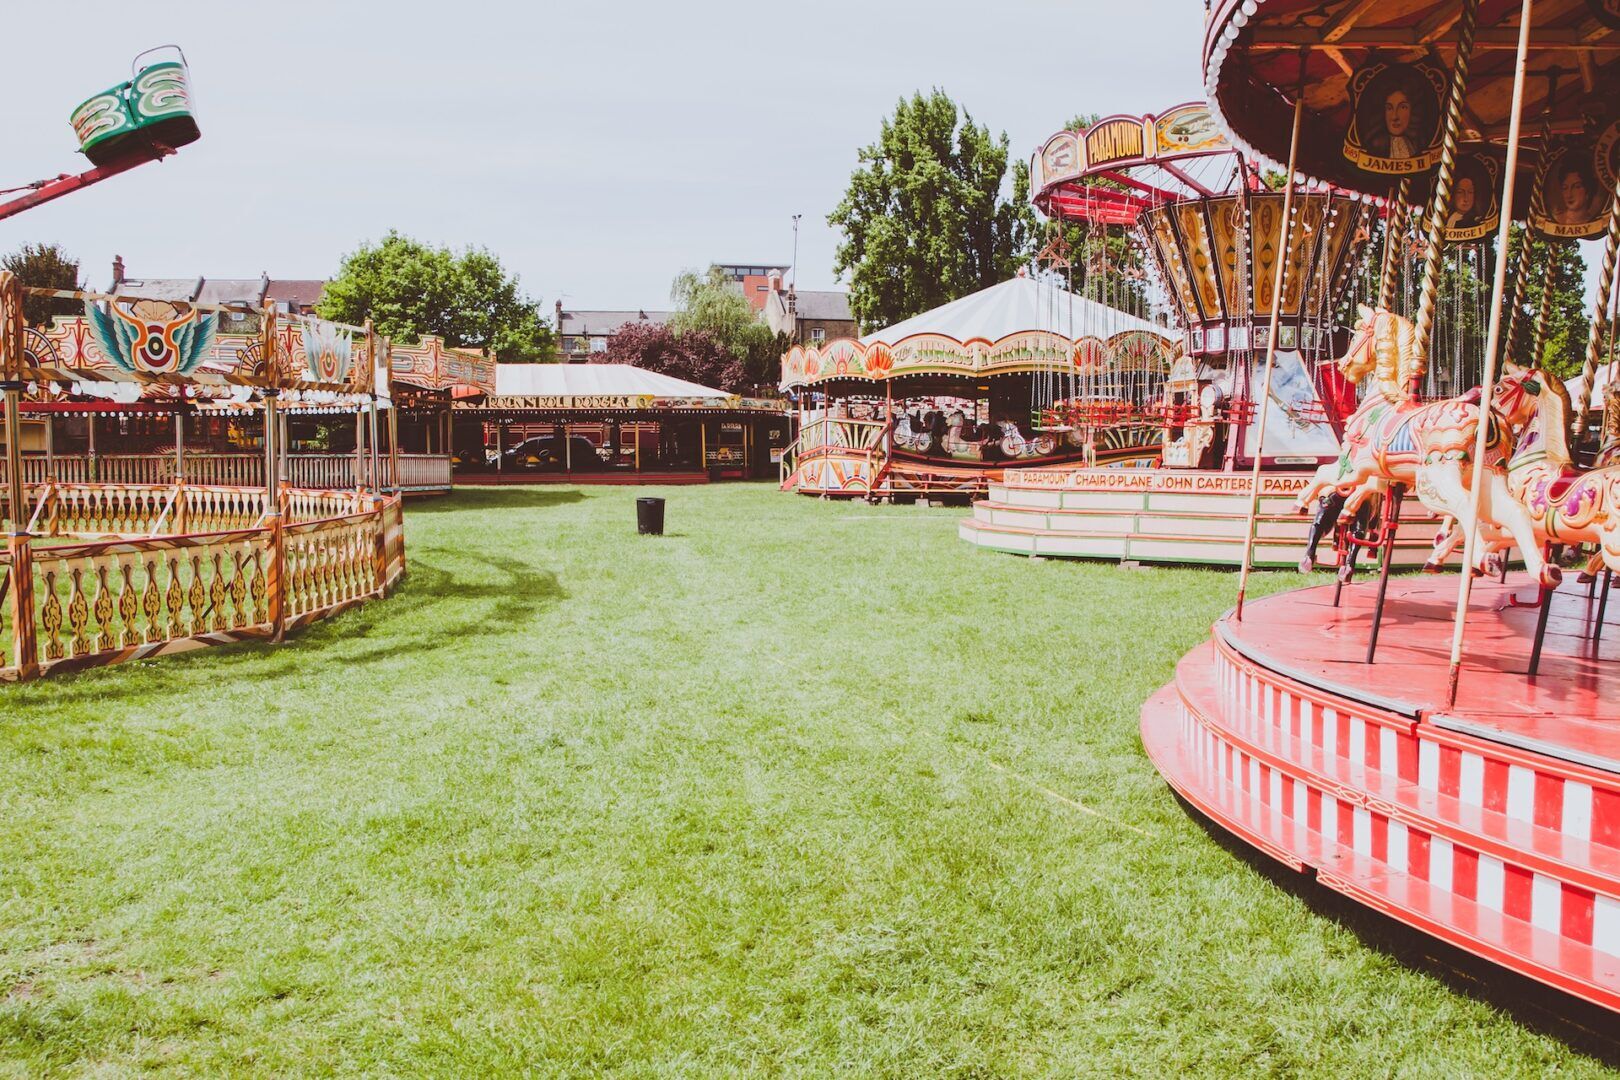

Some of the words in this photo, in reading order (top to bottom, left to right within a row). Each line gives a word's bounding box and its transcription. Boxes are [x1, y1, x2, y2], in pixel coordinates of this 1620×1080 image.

[1089, 121, 1142, 164] PARAMOUNT
[1363, 158, 1412, 171] JAMES
[1417, 158, 1426, 169] II
[1444, 229, 1477, 239] EORGE
[1554, 225, 1591, 235] MARY
[912, 341, 974, 366] JUNGLE
[978, 339, 1068, 366] THRILLER
[1023, 473, 1070, 485] PARAMOUNT
[1157, 476, 1193, 489] JOHN
